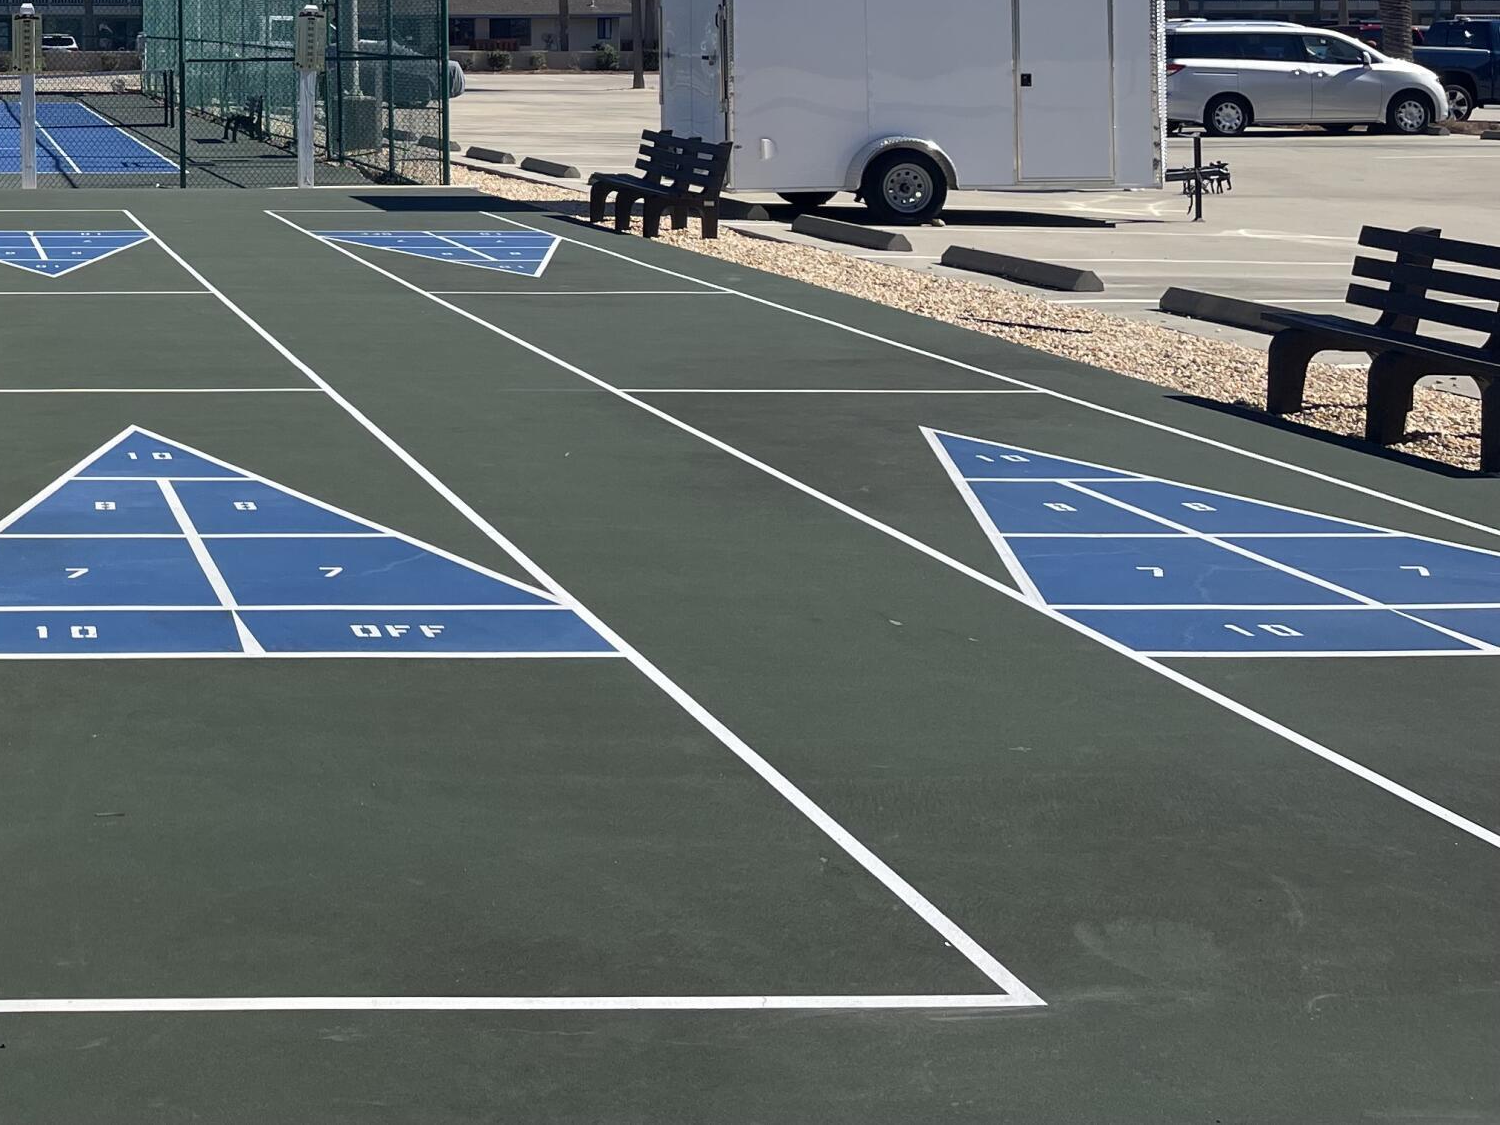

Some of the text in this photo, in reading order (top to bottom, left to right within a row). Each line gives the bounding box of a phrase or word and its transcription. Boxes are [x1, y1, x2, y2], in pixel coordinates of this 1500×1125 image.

[126, 452, 173, 460] 10
[975, 454, 1031, 462] 10
[94, 501, 116, 510] 8
[233, 501, 258, 510] 8
[65, 567, 89, 579] 7
[319, 566, 344, 578] 7
[1135, 566, 1164, 577] 7
[1399, 565, 1431, 577] 7
[36, 624, 445, 639] 10 OFF
[1224, 624, 1304, 636] 10
